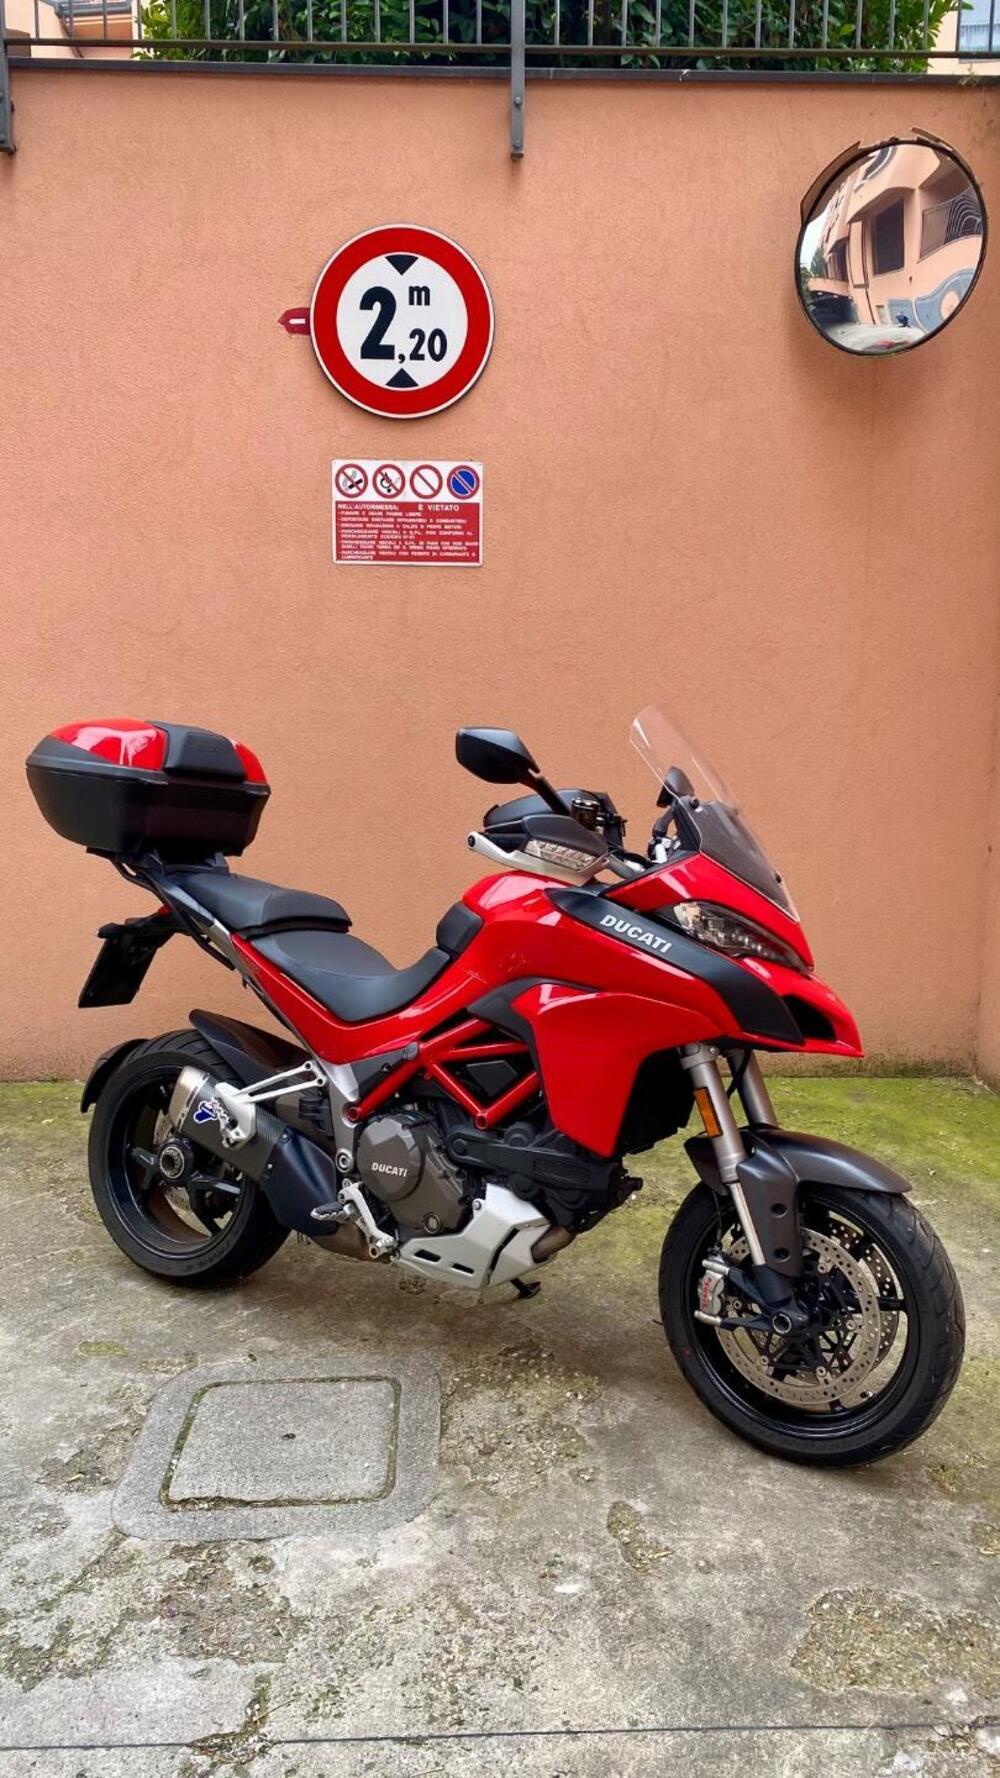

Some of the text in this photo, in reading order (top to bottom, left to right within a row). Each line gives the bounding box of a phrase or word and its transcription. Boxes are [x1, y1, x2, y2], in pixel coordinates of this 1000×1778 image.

[408, 286, 431, 306] m
[427, 504, 460, 512] VIETATO
[600, 914, 672, 953] DUCATI
[371, 1161, 408, 1178] DUCATI
